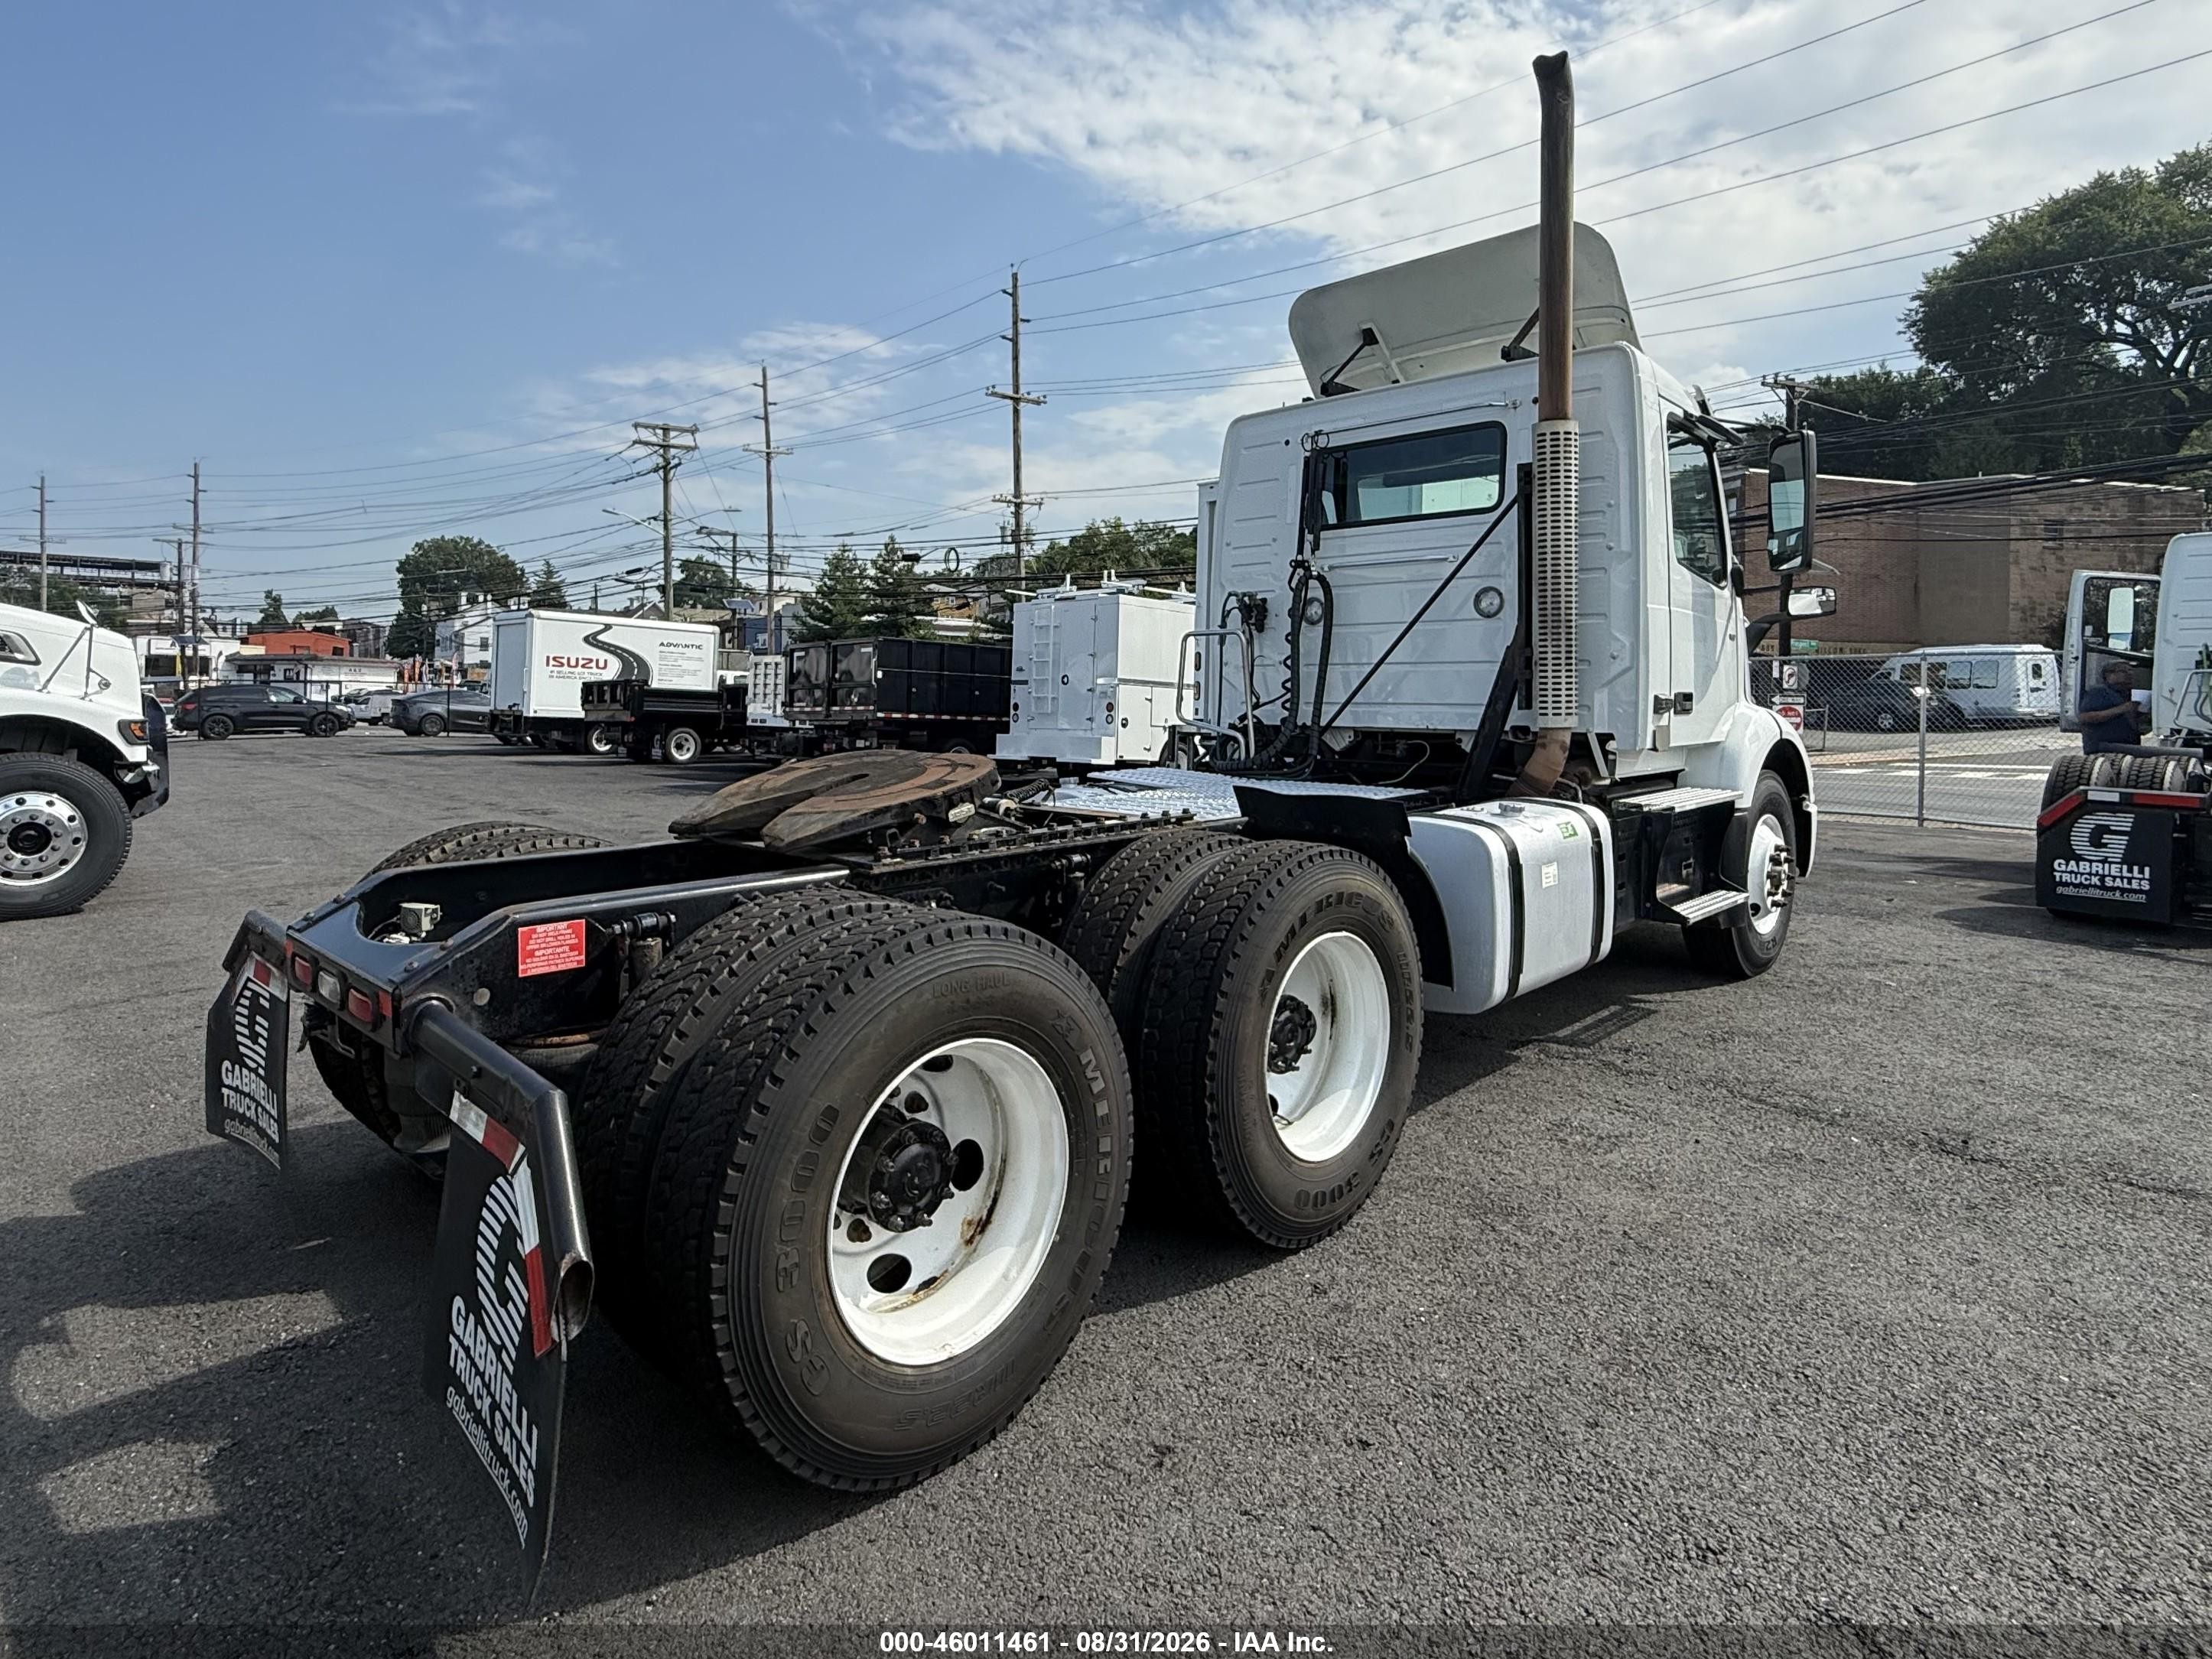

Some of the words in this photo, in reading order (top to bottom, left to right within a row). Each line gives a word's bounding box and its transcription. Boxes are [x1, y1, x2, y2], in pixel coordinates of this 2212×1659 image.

[659, 641, 703, 650] ADVANTIC
[545, 655, 608, 670] ISUZU
[2053, 859, 2151, 880] GABRIELLI
[2053, 872, 2101, 886] TRUCK
[2104, 877, 2151, 891] SALES
[2055, 885, 2146, 902] gabriellitruck.com
[536, 923, 568, 933] IMPORTANT
[535, 945, 571, 957] IMPORTANTE
[932, 980, 970, 998] LONG
[975, 972, 1010, 992] HAUL
[221, 1059, 278, 1121] GABRIELLI
[221, 1087, 257, 1124] TRUCK
[257, 1107, 280, 1144] SALES
[776, 1103, 840, 1293] 3000
[1294, 1171, 1361, 1211] 3000
[451, 1295, 538, 1472] GABRIELLI
[449, 1333, 492, 1430] TRUCK
[493, 1408, 535, 1508] SALES
[446, 1384, 529, 1542] gabriellitruck.com
